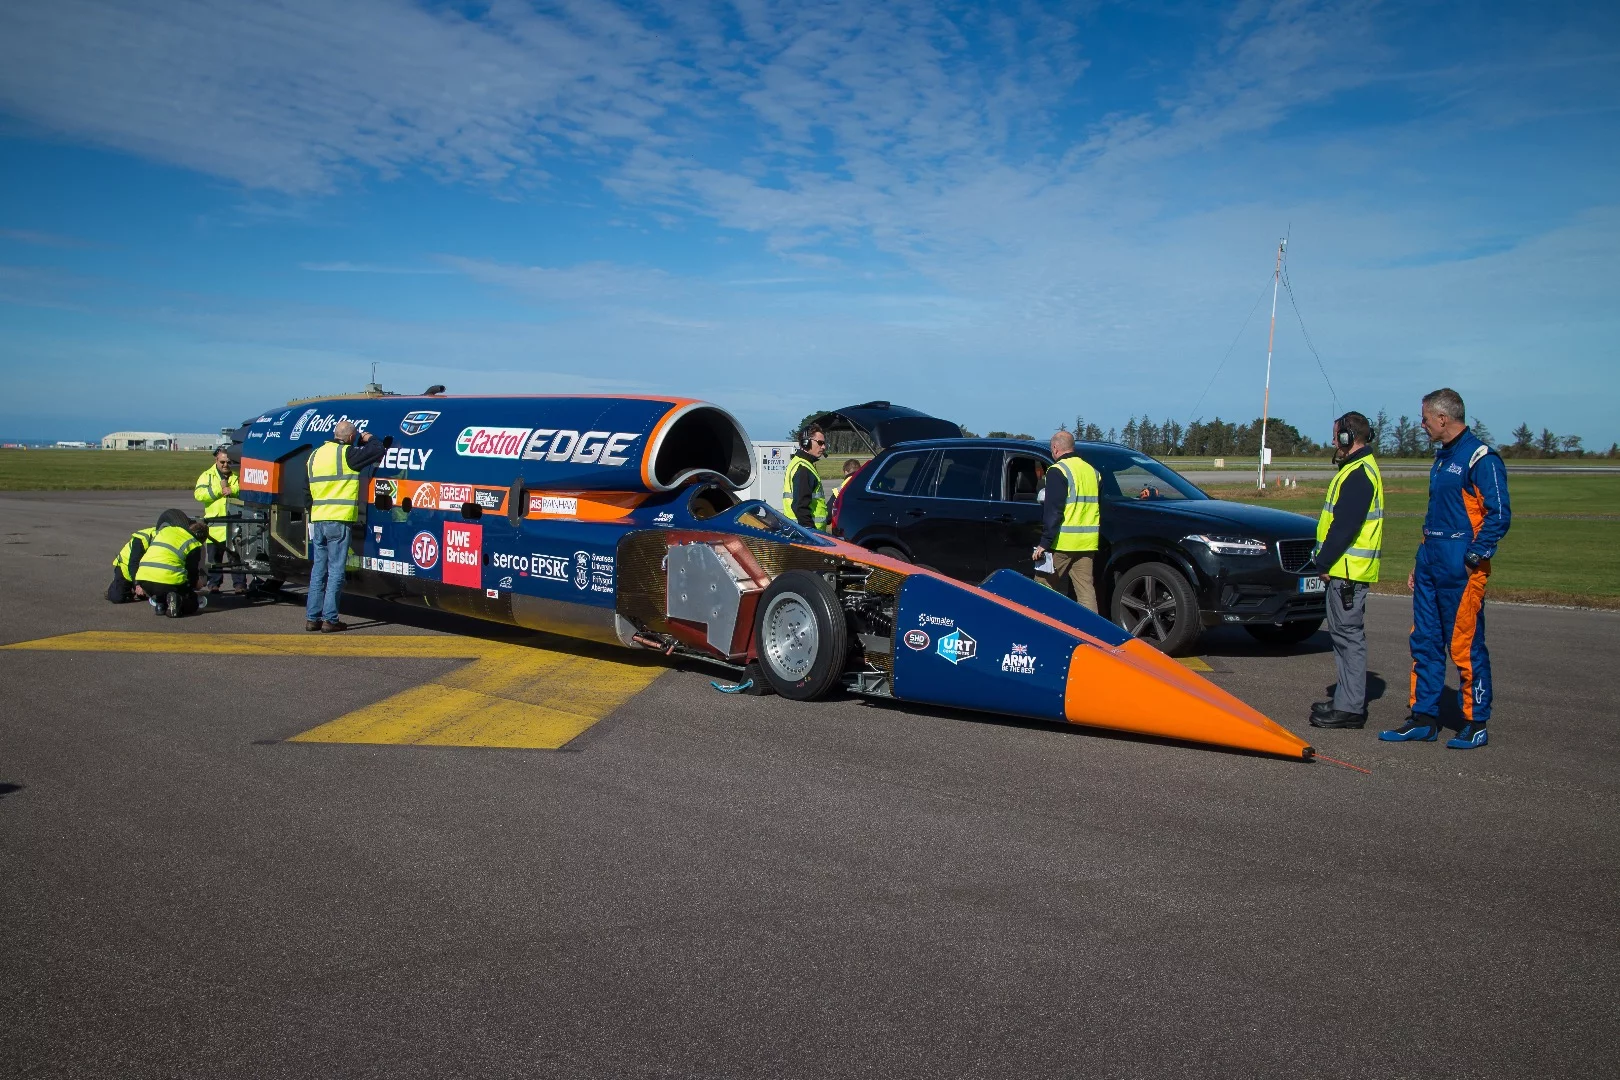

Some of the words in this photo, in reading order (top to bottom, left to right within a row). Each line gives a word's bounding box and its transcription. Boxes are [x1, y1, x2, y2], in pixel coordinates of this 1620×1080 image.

[470, 429, 527, 455] Castrol
[522, 429, 642, 466] EDGE
[443, 486, 471, 502] GREAT
[422, 497, 436, 507] CLA
[446, 529, 471, 547] UWE
[414, 536, 436, 564] STP
[446, 546, 478, 566] Bristol
[591, 553, 614, 562] Swansea
[493, 552, 528, 571] serco
[531, 557, 569, 578] EPSRC
[591, 561, 614, 572] University
[909, 634, 925, 643] SHD
[943, 637, 973, 652] URT
[1002, 653, 1037, 668] ARMY
[1009, 665, 1020, 673] THE
[1020, 666, 1036, 674] BEST
